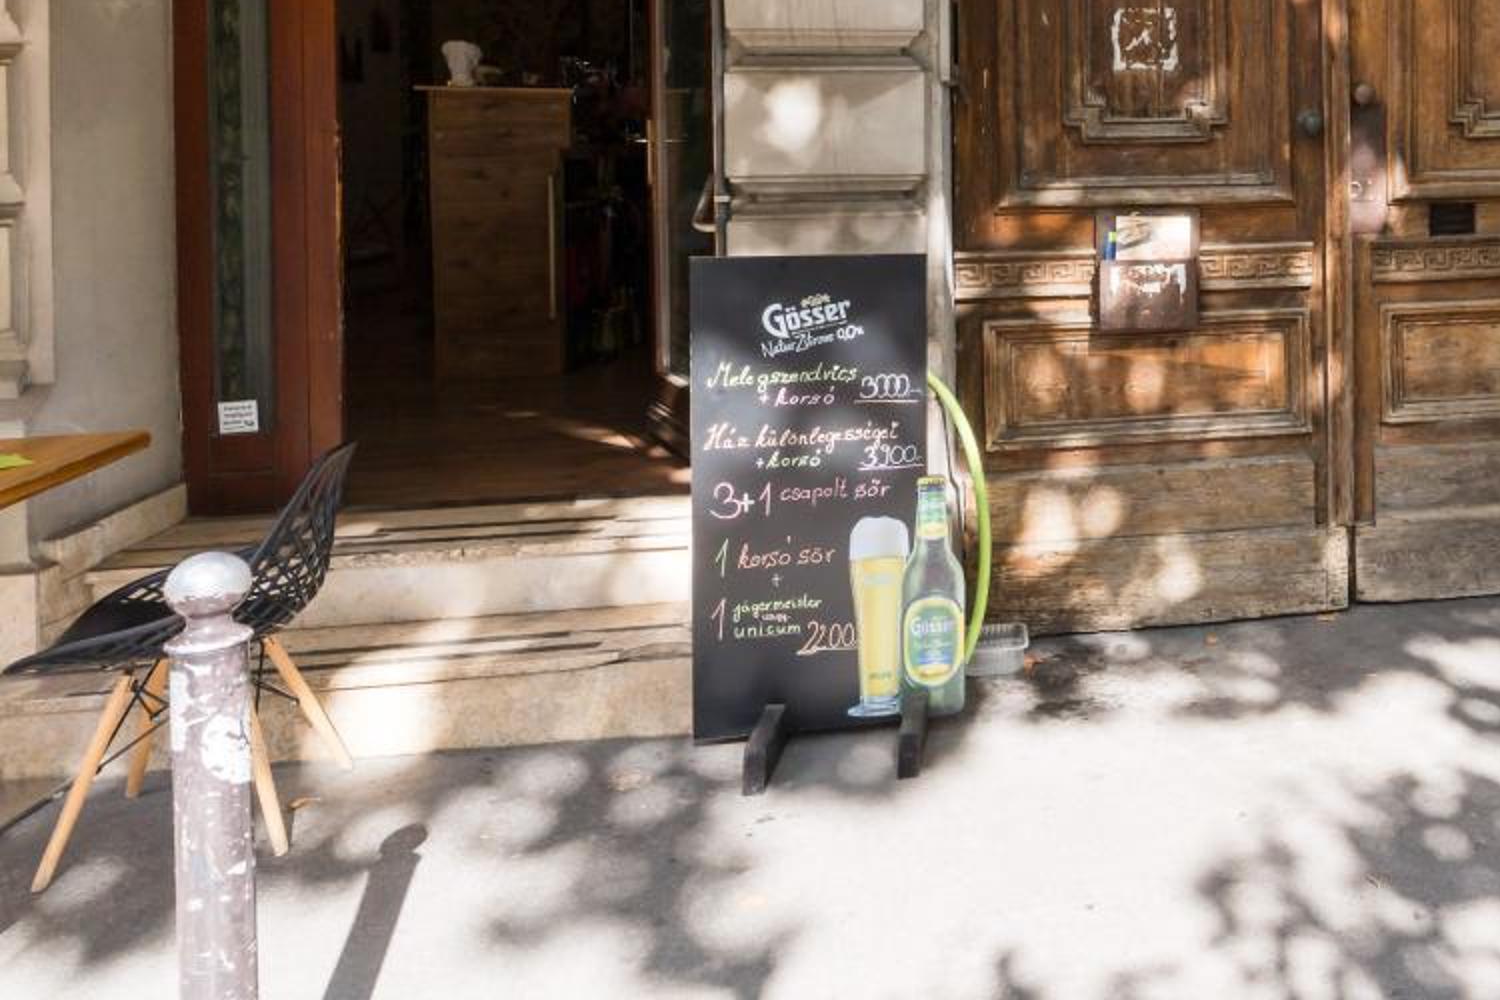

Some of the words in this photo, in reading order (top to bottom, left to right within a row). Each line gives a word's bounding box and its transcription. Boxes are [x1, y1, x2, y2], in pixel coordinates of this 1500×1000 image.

[762, 300, 851, 339] Gösser
[703, 422, 751, 452] Ház
[780, 476, 849, 507] csapolt
[715, 538, 729, 578] 1
[798, 547, 837, 565] sör
[711, 598, 727, 641] 1
[734, 623, 801, 638] unicum
